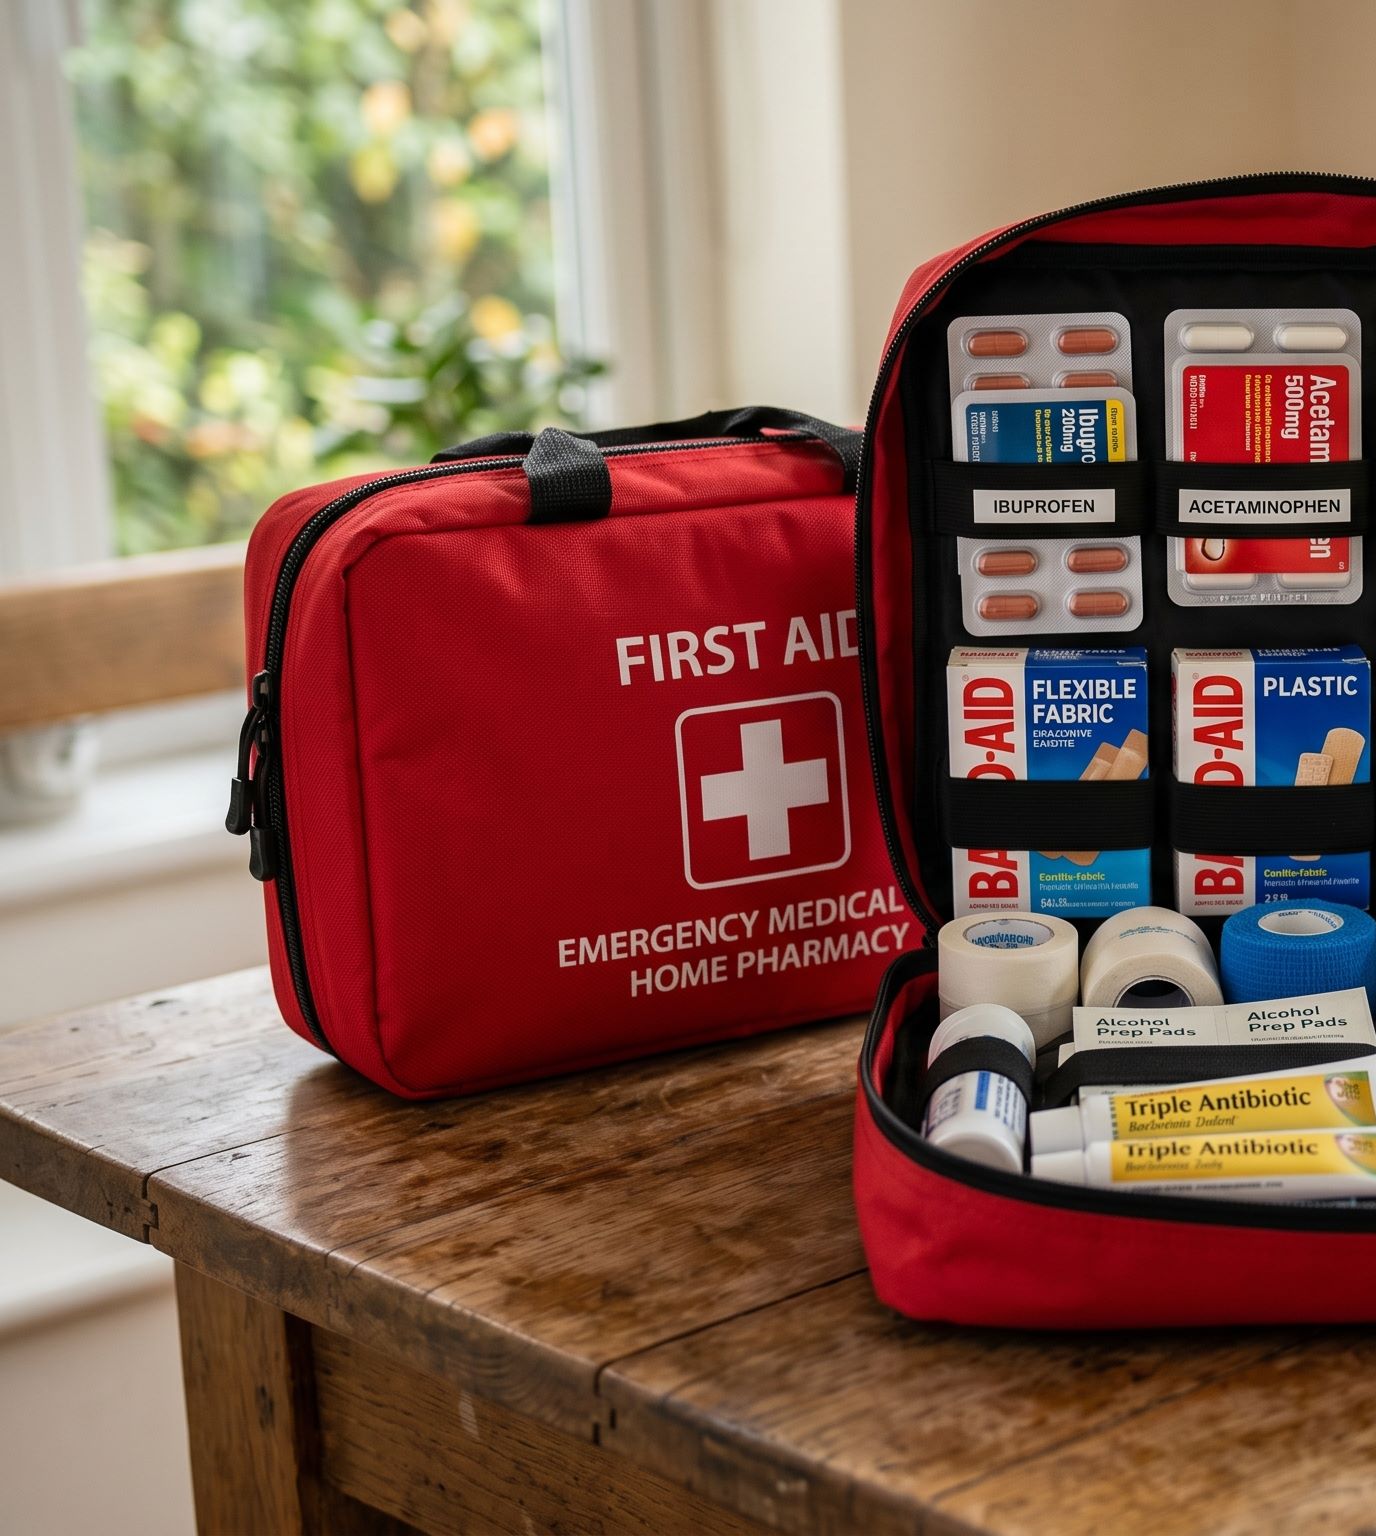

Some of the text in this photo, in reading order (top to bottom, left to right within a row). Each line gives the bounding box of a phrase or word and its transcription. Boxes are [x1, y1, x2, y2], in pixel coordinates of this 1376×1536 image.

[1281, 374, 1304, 440] 500mg
[1059, 408, 1076, 453] 200mg
[1075, 408, 1099, 464] Ibupro
[993, 498, 1095, 514] IBUPROFEN
[1188, 498, 1341, 516] ACETAMINOPHEN
[616, 621, 766, 686] FIRST
[1033, 678, 1137, 700] FLEXIBLE
[1263, 675, 1358, 697] PLASTIC
[1033, 703, 1114, 724] FABRIC
[558, 886, 904, 968] EMERGENCY MEDICAL
[630, 922, 910, 998] HOME PHARMACY
[1096, 1018, 1170, 1027] Alcohol
[1247, 1005, 1320, 1022] Alcohol
[1249, 1016, 1348, 1033] Prep Pads
[1097, 1027, 1197, 1038] Prep Pads
[1124, 1087, 1311, 1120] Triple Antibiotic
[1124, 1138, 1318, 1162] Triple Antibiotic
